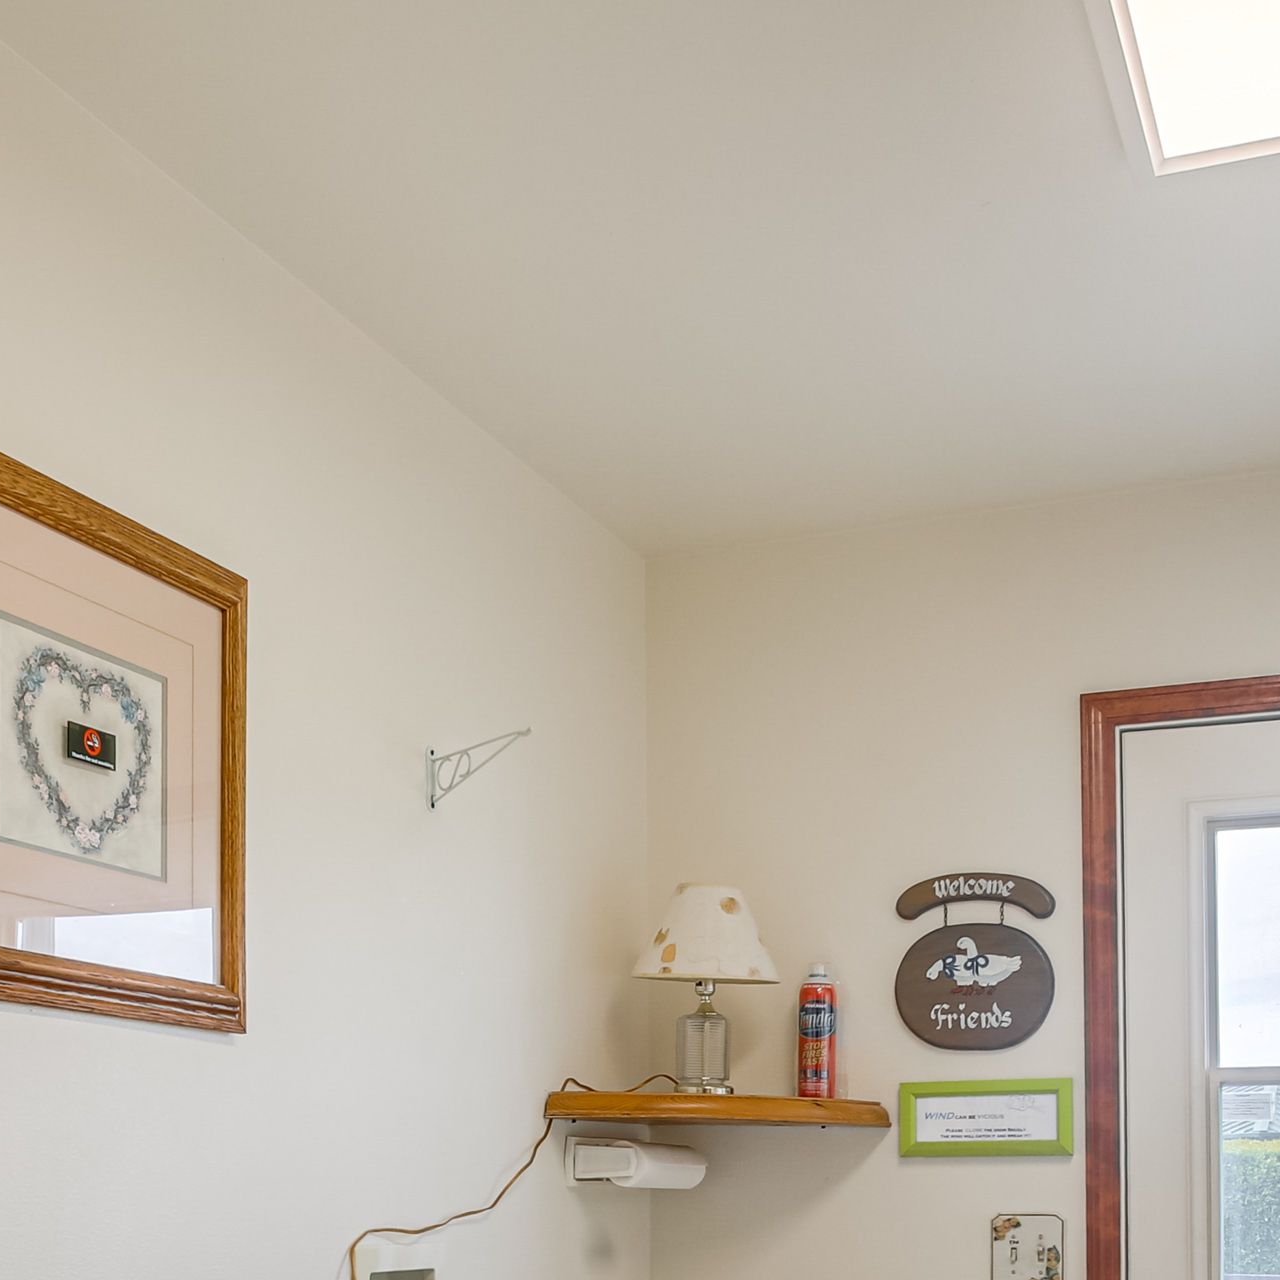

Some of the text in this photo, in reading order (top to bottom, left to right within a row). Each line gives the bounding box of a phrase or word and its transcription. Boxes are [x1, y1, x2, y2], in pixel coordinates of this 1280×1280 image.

[932, 876, 1016, 898] Welcome
[930, 1002, 1013, 1031] Friends
[924, 1112, 955, 1120] WIND
